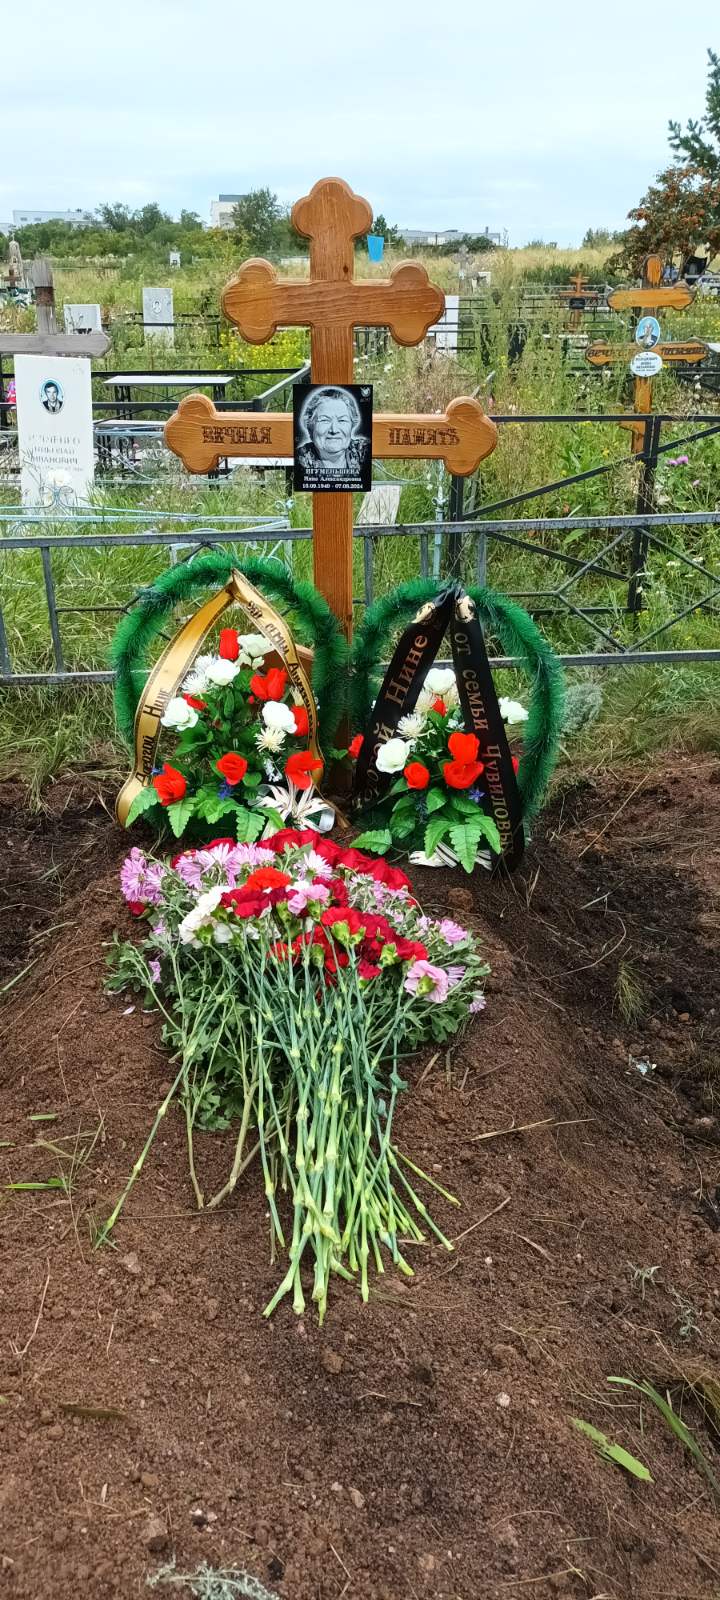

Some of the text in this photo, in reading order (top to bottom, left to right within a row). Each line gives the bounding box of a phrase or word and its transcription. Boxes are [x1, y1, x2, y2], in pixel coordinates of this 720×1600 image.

[201, 426, 461, 446] ВЕЧНАЯ ПАМЯТЬ
[384, 634, 428, 704] Нине
[453, 632, 471, 656] от
[462, 668, 489, 730] семьи
[142, 687, 169, 718] Нине
